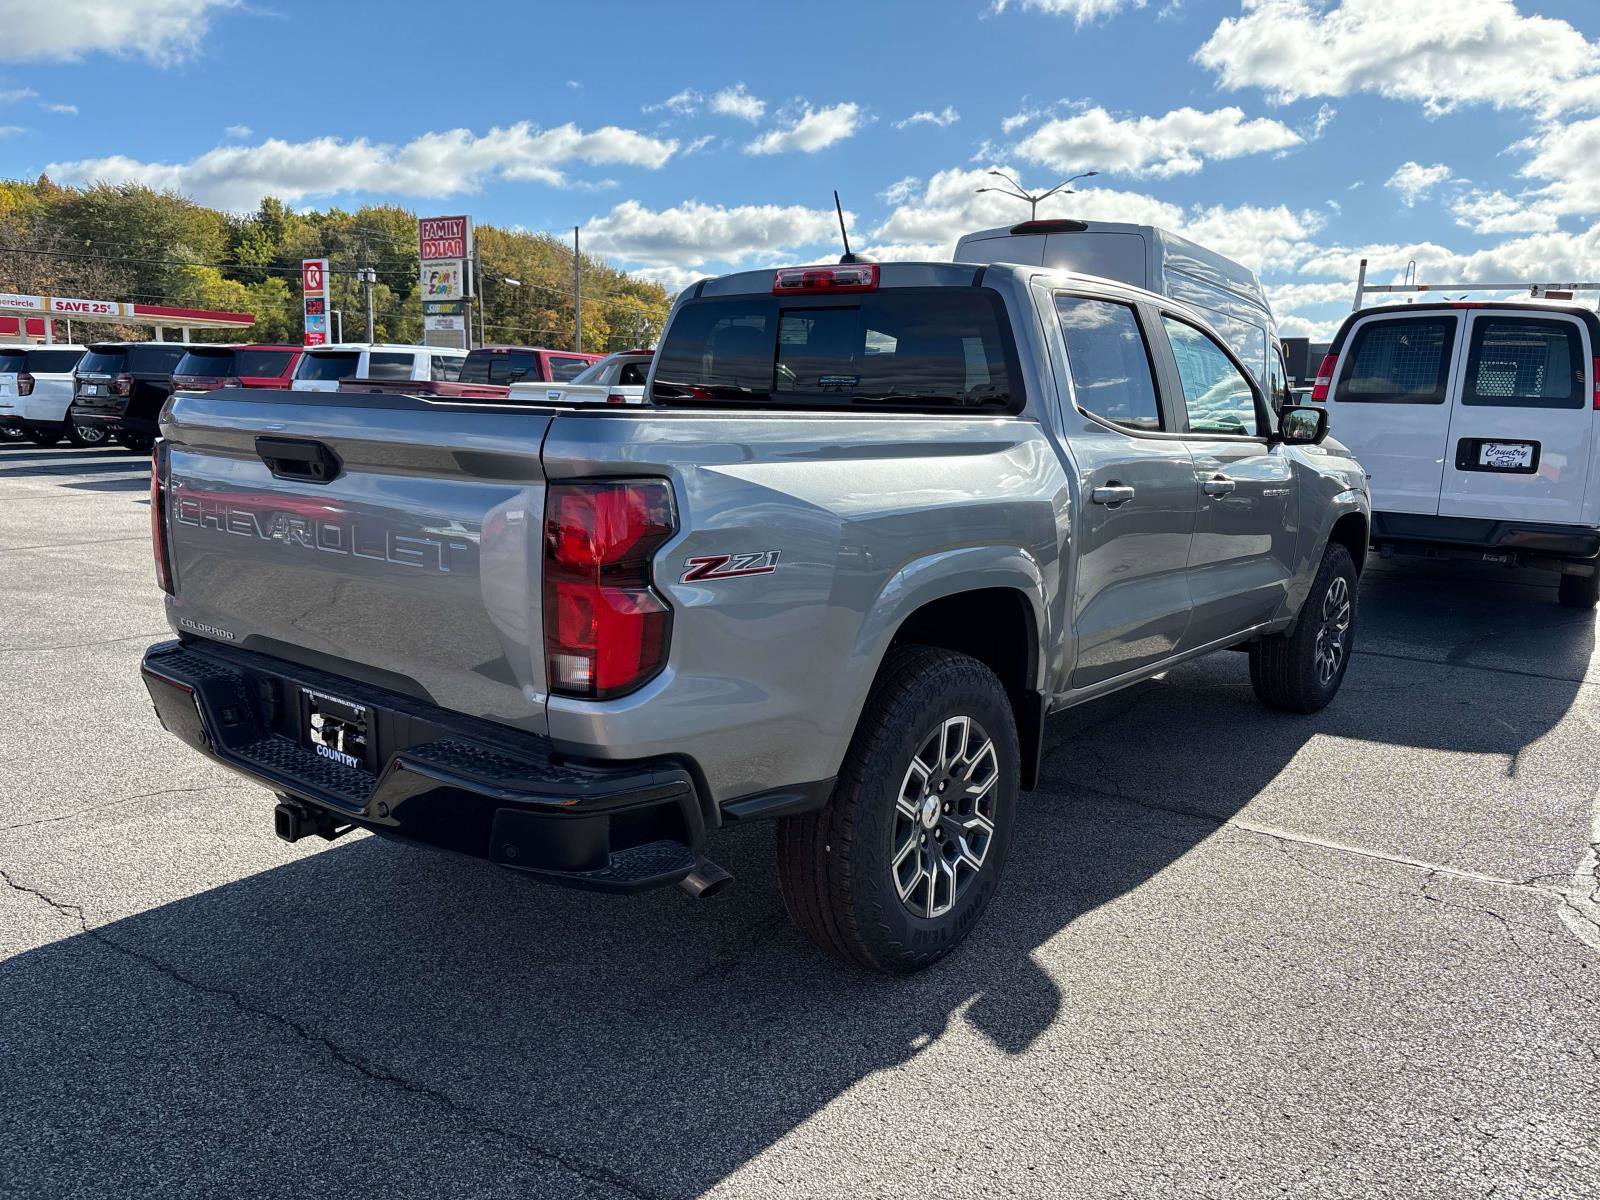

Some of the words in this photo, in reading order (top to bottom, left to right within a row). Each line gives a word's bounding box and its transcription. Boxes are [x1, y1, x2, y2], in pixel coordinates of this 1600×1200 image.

[422, 220, 463, 239] FAMILY
[423, 239, 463, 258] DOLLAR
[55, 301, 90, 312] SAVE
[426, 303, 457, 313] SUBWAY
[1485, 445, 1528, 459] Country
[176, 498, 468, 573] CHEVROLET
[678, 549, 782, 584] Z71
[180, 617, 235, 640] COLORADO
[316, 744, 358, 768] COUNTRY
